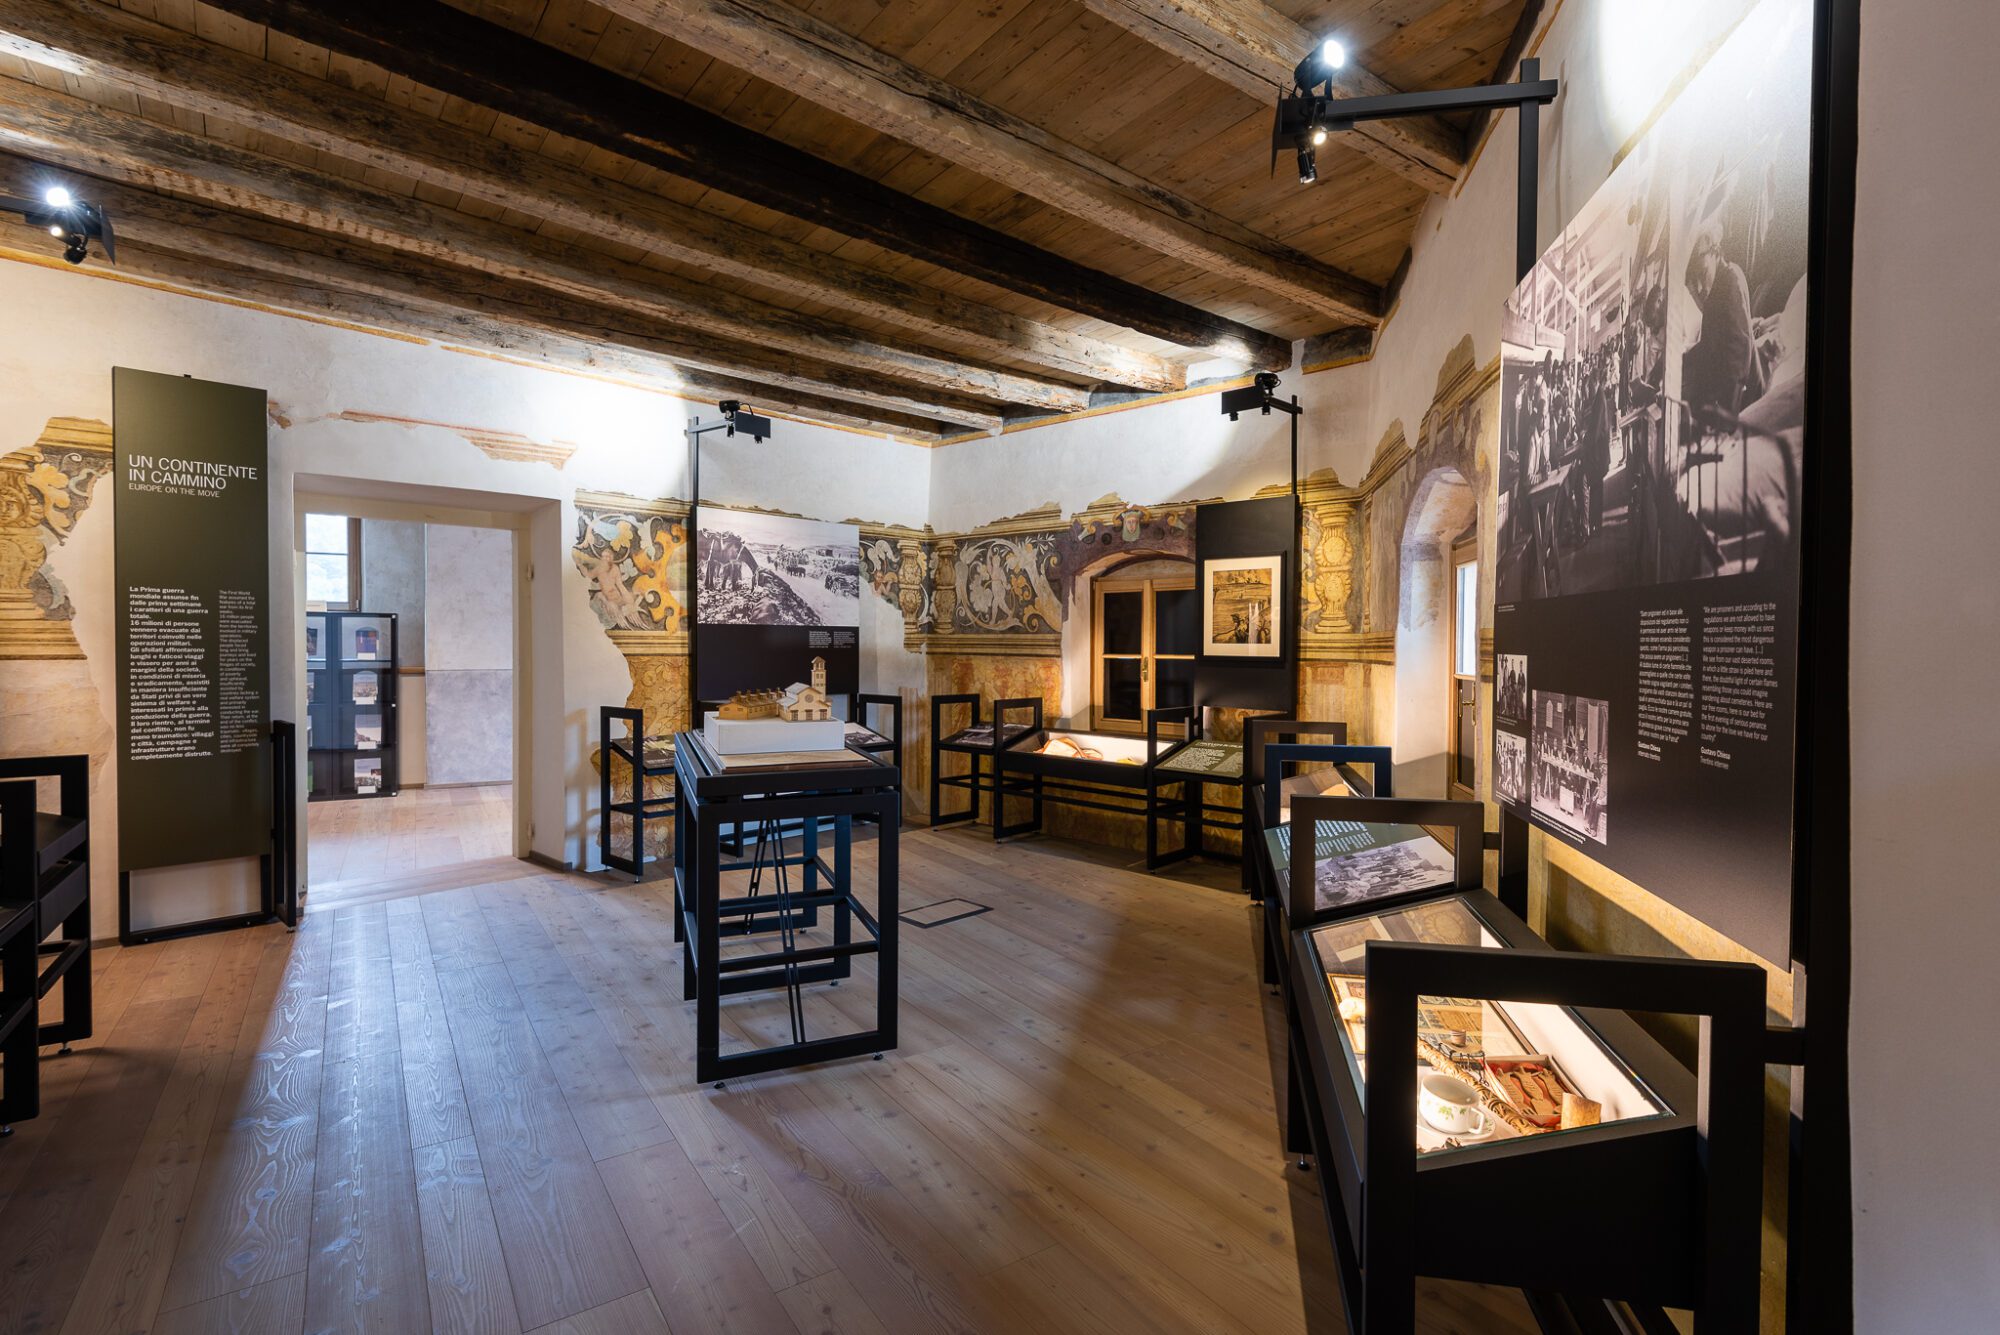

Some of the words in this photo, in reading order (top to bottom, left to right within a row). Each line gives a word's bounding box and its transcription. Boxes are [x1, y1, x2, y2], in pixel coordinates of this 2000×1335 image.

[129, 454, 152, 468] UN
[158, 458, 257, 480] CONTINENTE
[129, 469, 144, 482] IN
[151, 471, 226, 489] CAMMINO
[129, 483, 162, 492] EUROPE
